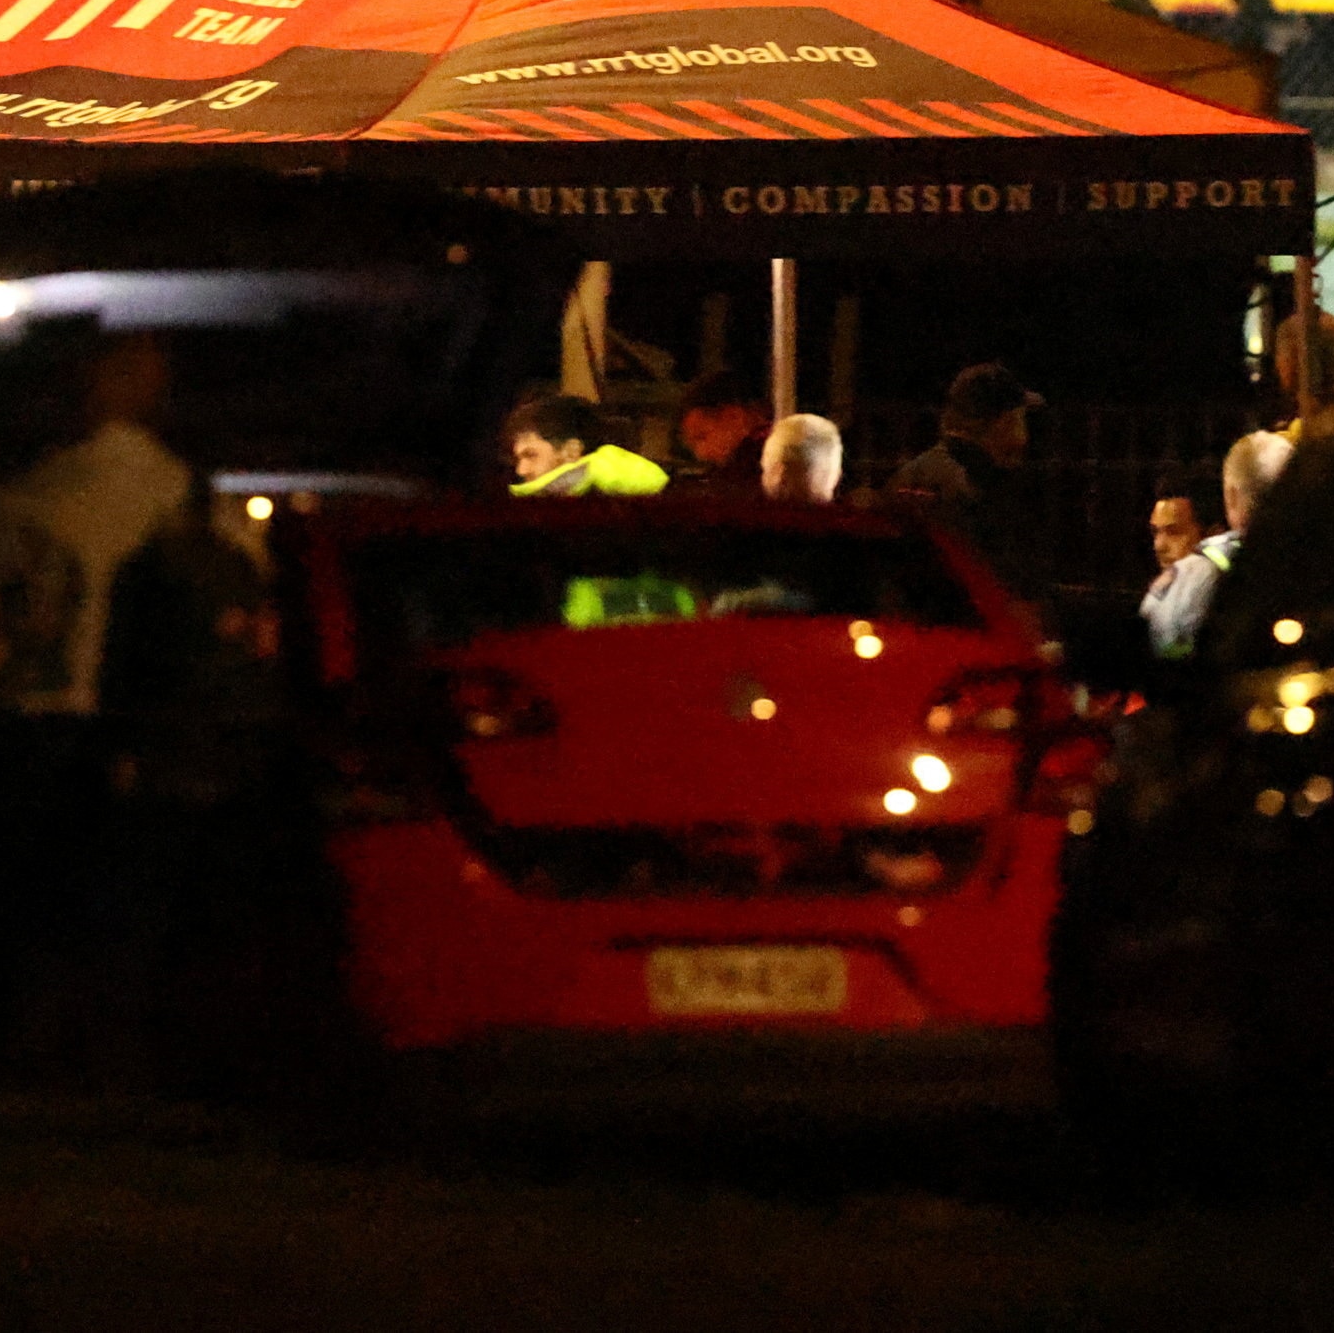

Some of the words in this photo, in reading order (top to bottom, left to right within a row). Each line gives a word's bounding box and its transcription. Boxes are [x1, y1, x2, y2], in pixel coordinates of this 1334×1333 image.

[173, 7, 287, 45] TEAM
[453, 40, 879, 87] www.rrtglobal.org
[462, 185, 671, 215] MUNITY
[722, 182, 1034, 215] COMPASSION
[1086, 178, 1298, 211] SUPPORT
